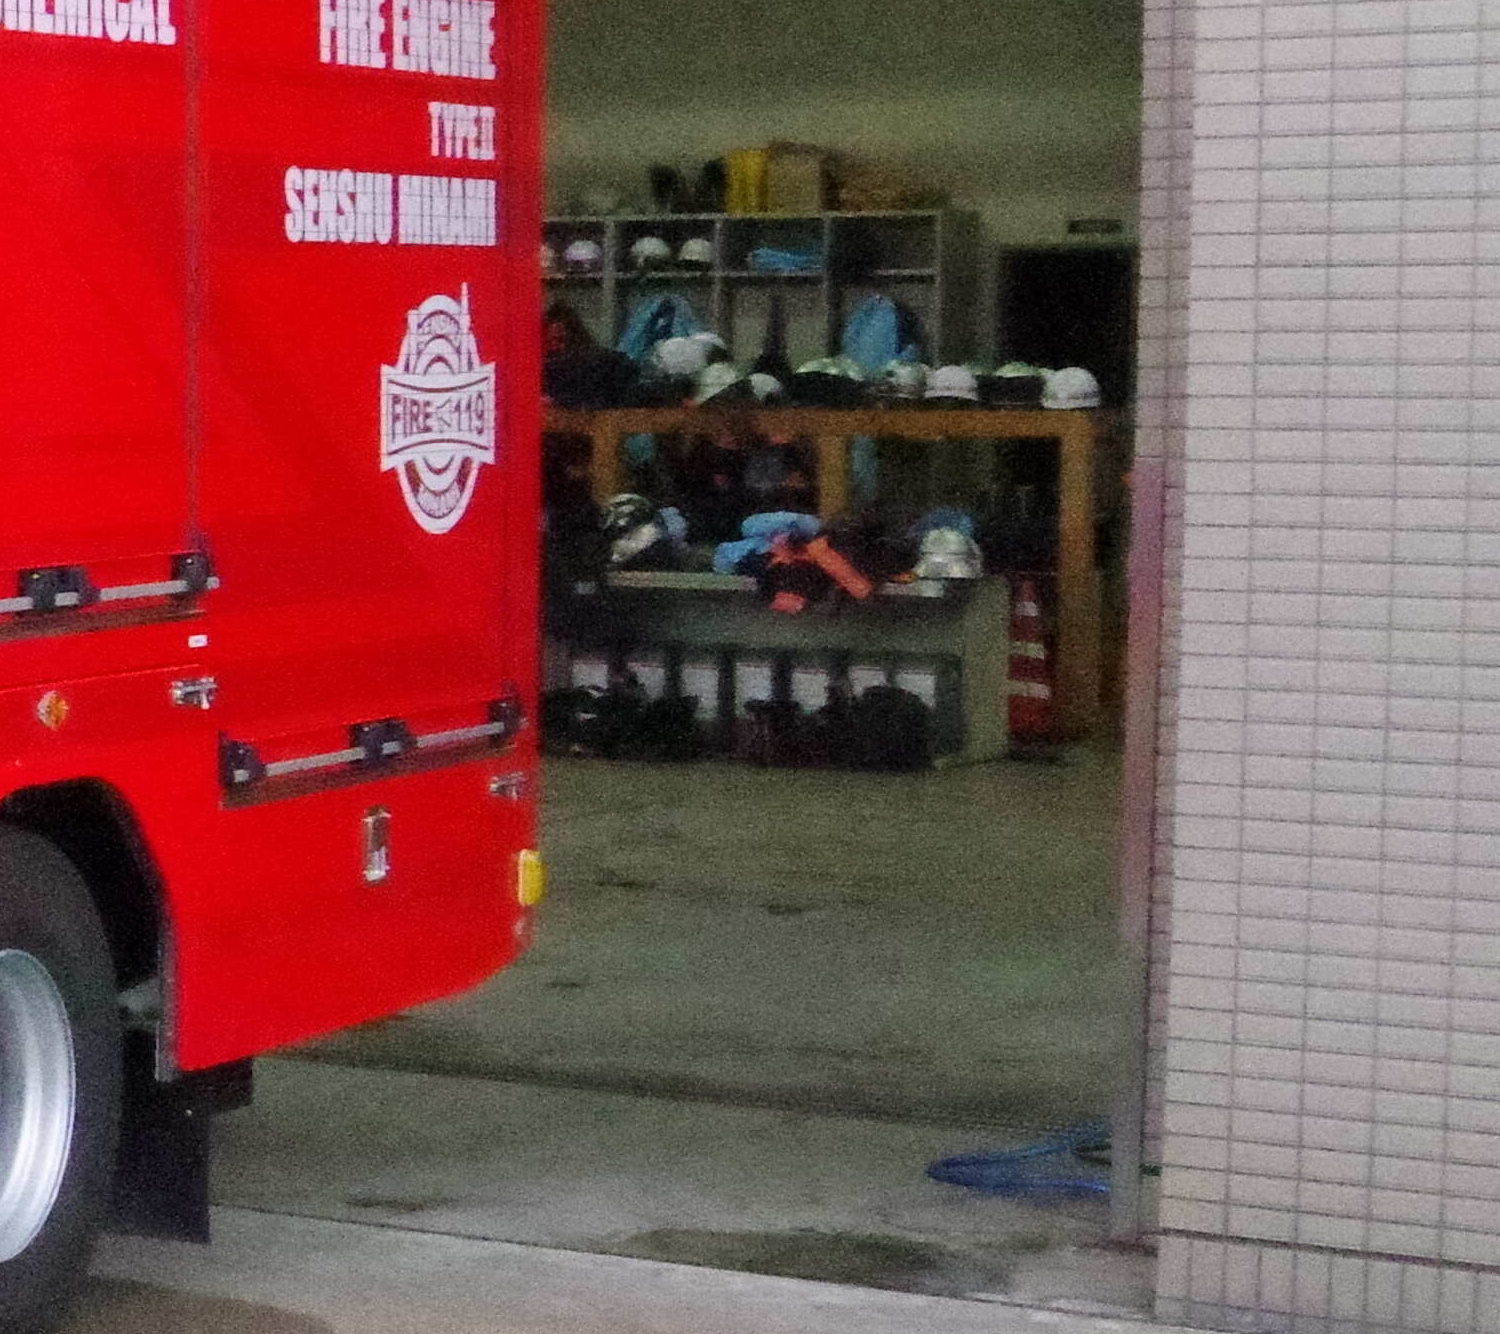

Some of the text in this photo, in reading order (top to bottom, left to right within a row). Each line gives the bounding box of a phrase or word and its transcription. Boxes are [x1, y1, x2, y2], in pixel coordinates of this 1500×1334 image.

[284, 165, 497, 247] SENSHU MINAMI
[391, 392, 486, 443] FIRE 119
